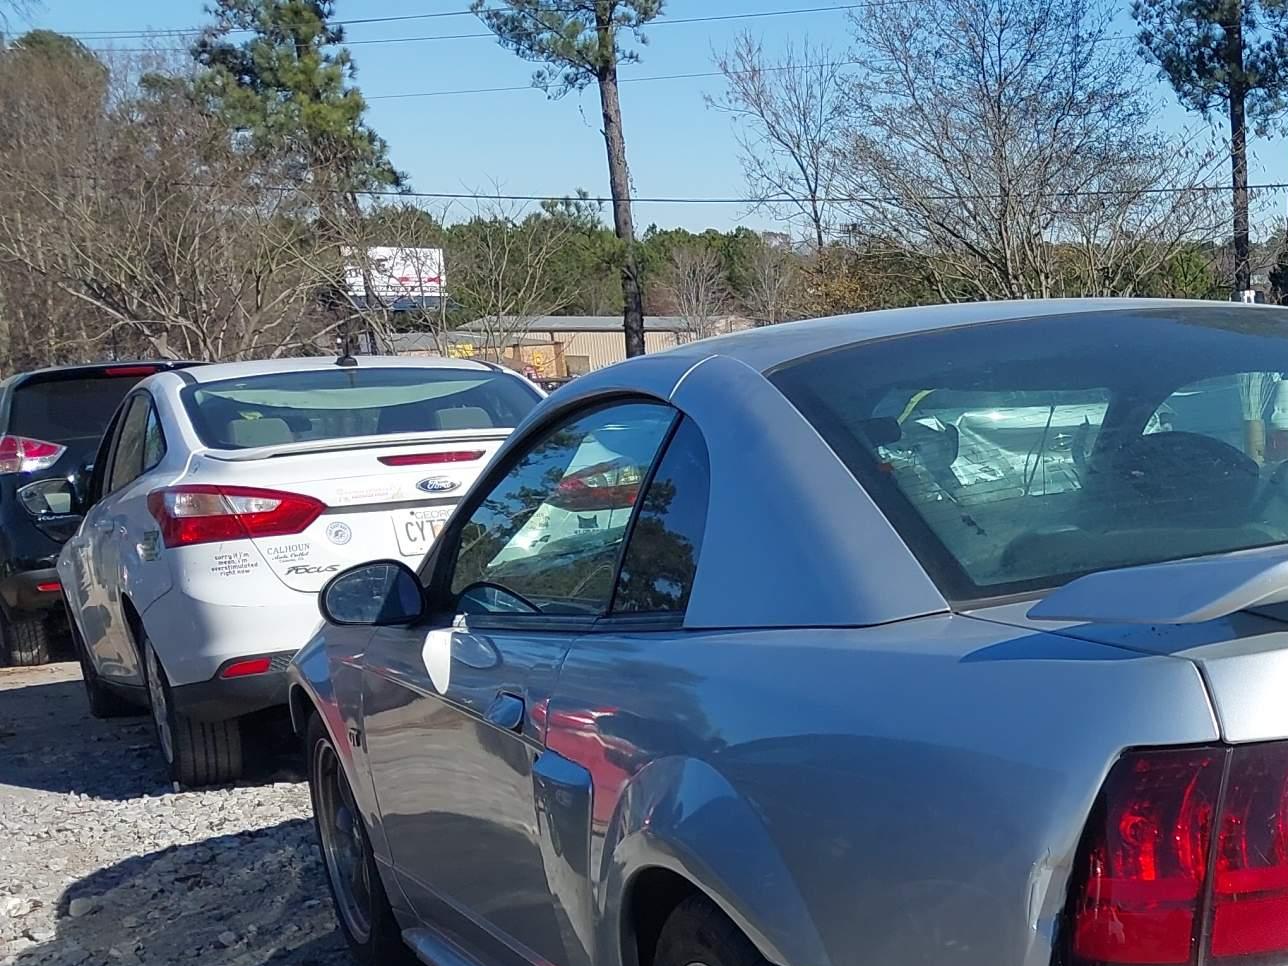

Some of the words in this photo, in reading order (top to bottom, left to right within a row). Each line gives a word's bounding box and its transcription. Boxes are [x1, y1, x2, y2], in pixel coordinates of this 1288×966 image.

[405, 518, 446, 542] CYT
[266, 543, 310, 555] CALHOUN
[285, 564, 341, 575] FOCUS
